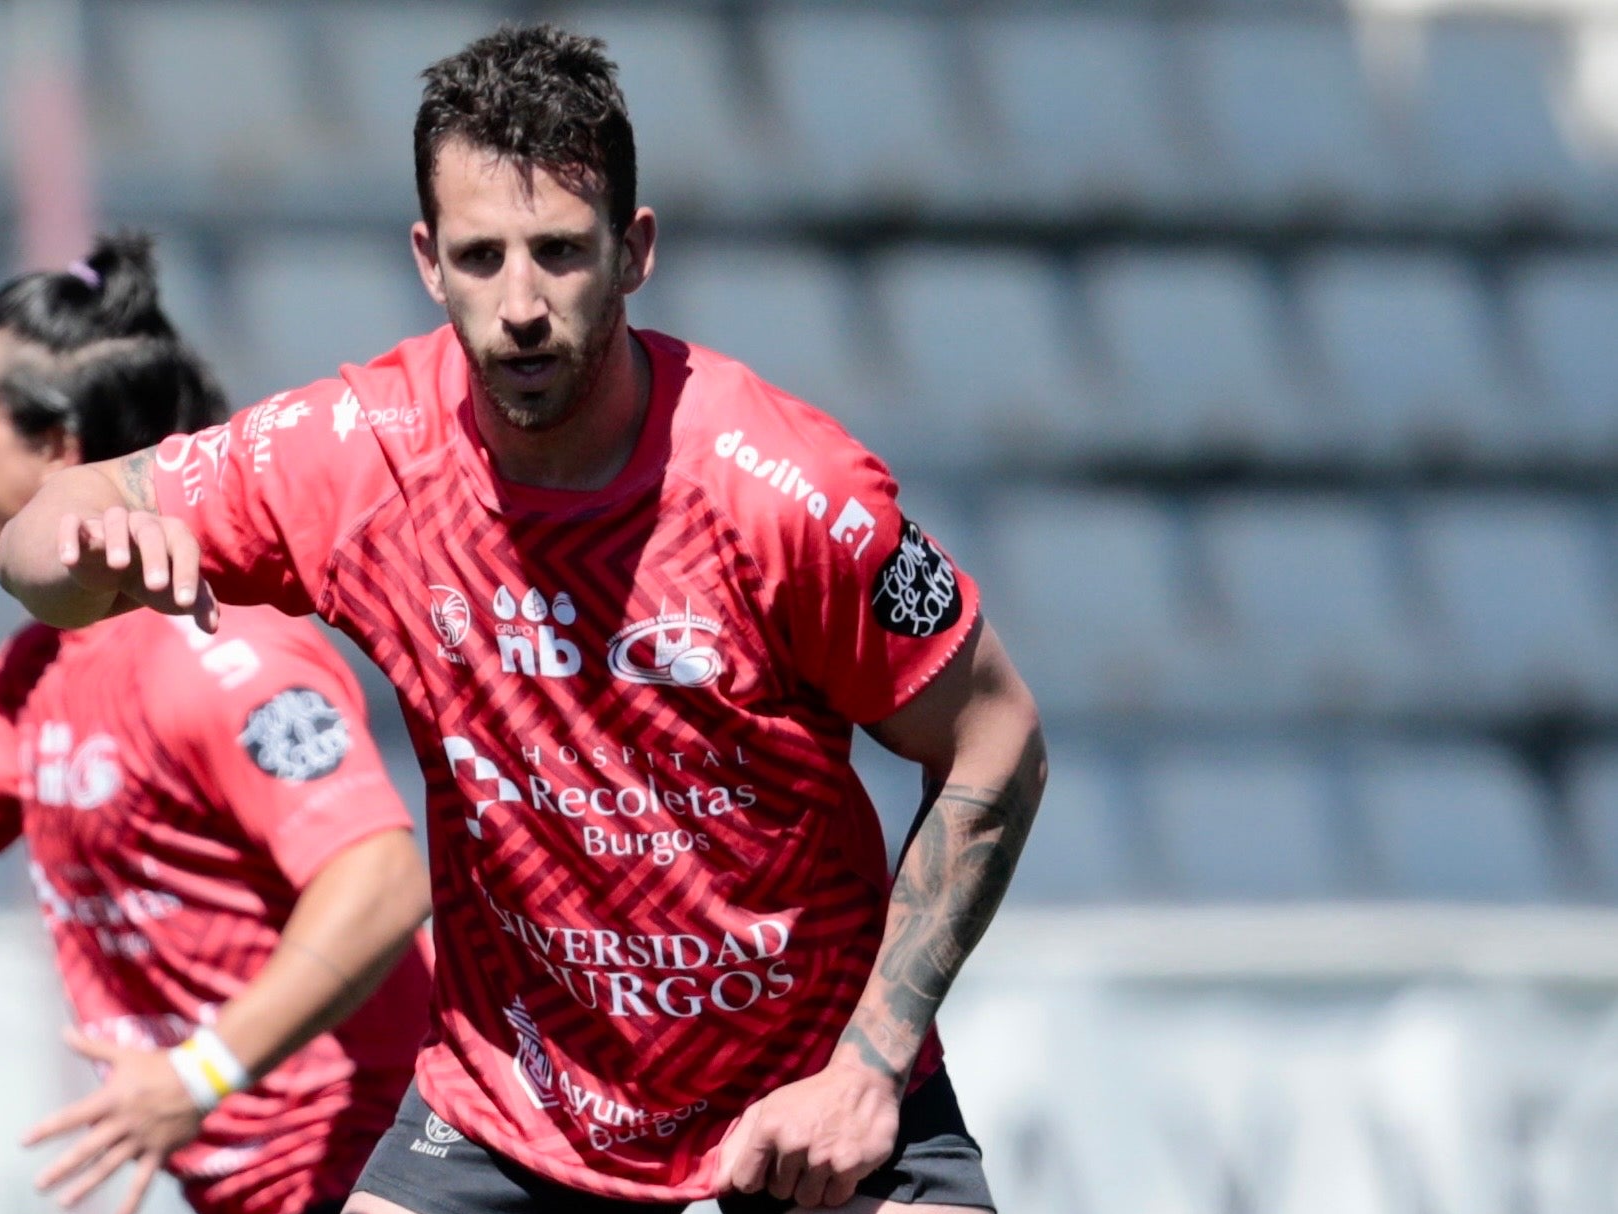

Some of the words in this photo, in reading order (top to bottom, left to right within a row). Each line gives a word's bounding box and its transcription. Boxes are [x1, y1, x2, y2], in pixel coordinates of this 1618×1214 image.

[714, 429, 828, 520] dasilva
[496, 625, 582, 678] nb
[521, 745, 750, 771] HOSPITAL
[529, 773, 757, 818] Recoletas
[582, 824, 711, 867] Burgos
